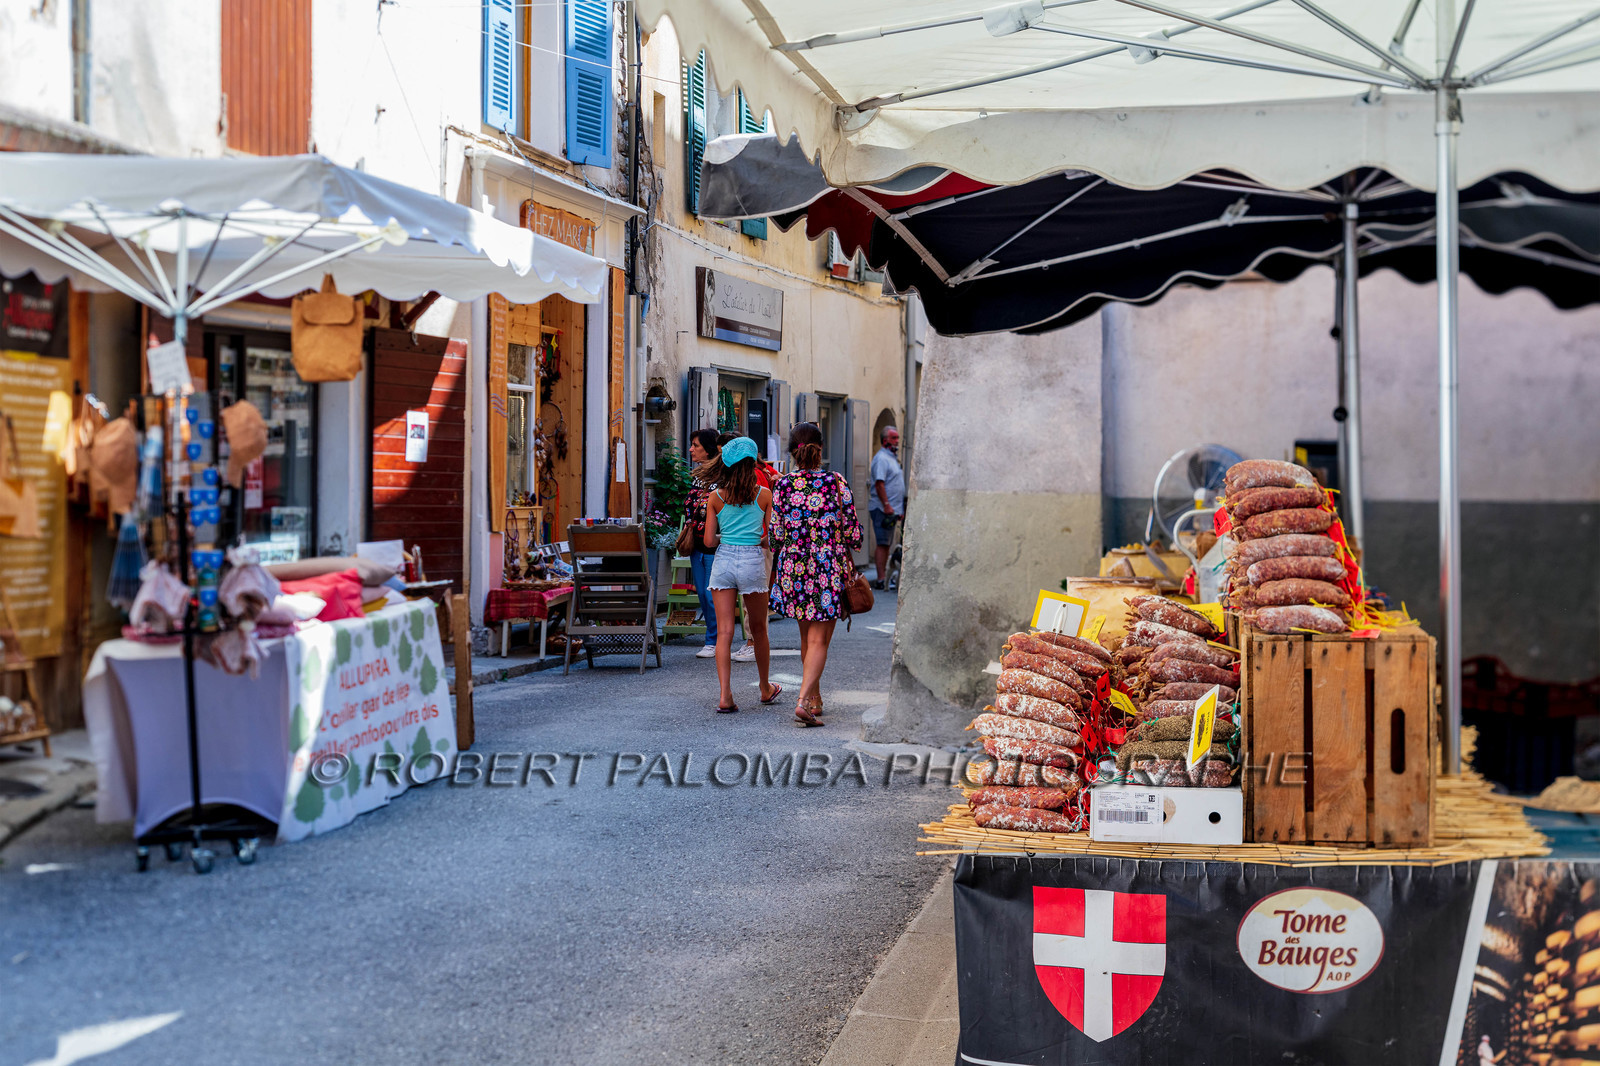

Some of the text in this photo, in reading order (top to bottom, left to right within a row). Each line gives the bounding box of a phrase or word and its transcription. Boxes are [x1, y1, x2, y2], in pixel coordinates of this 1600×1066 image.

[528, 208, 585, 251] CHEZ MARC
[1273, 910, 1347, 933] Tome
[1285, 936, 1300, 944] des
[1257, 940, 1358, 991] Bauges
